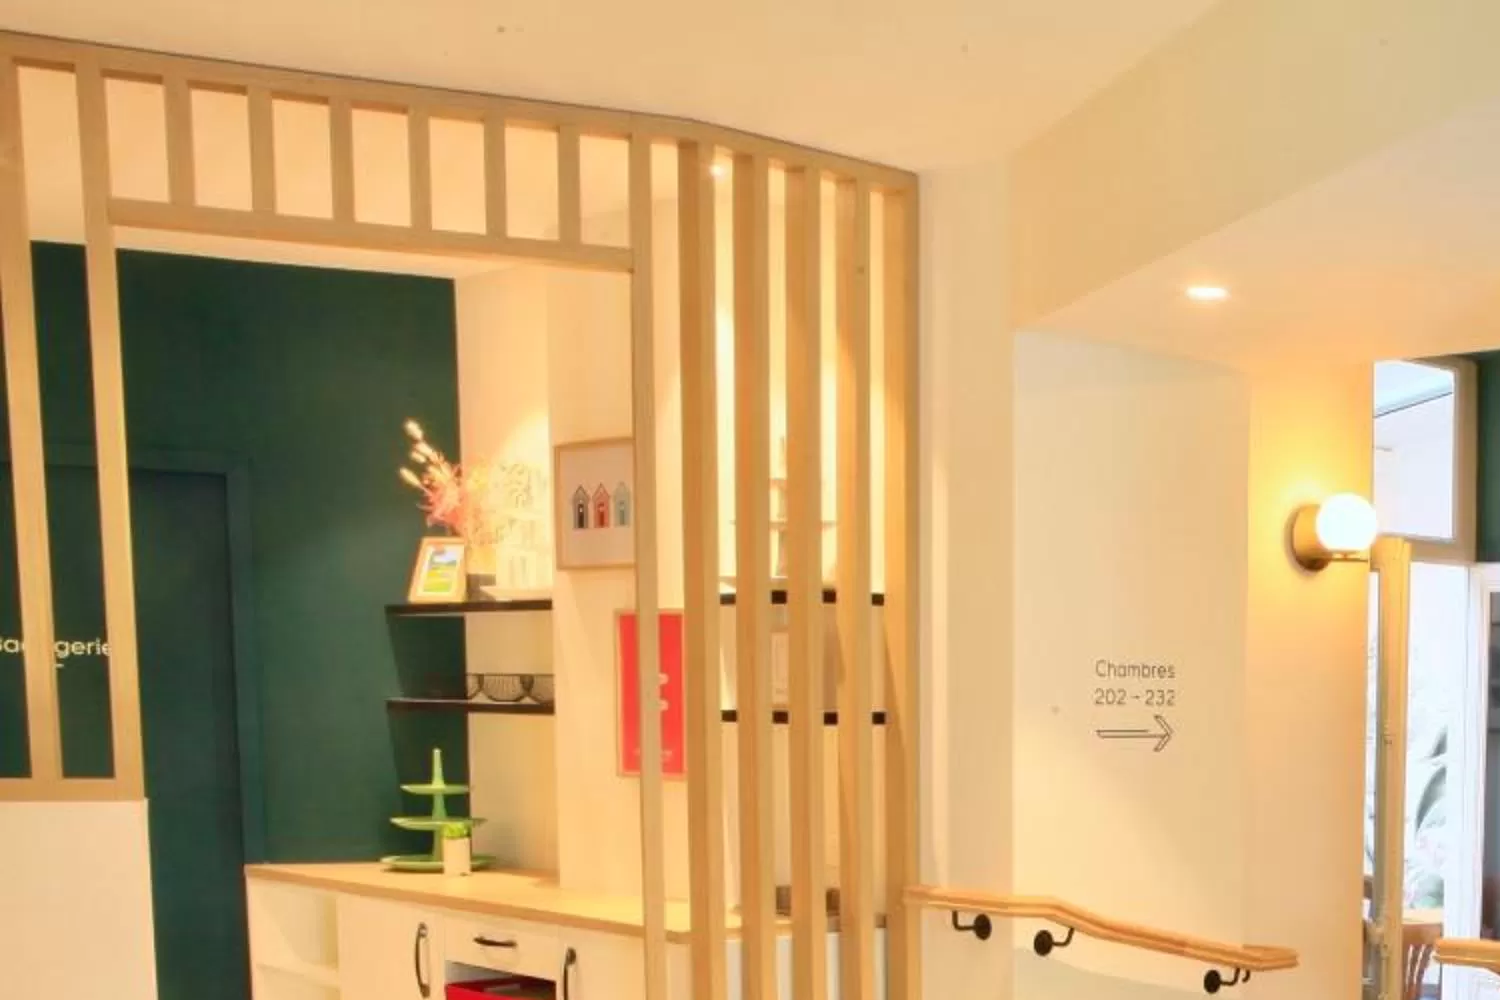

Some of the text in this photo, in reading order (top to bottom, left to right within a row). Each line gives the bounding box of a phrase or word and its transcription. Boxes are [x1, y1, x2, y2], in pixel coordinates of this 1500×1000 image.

[1095, 658, 1176, 679] Chambres
[1094, 687, 1127, 706] 202
[1145, 689, 1176, 706] 232
